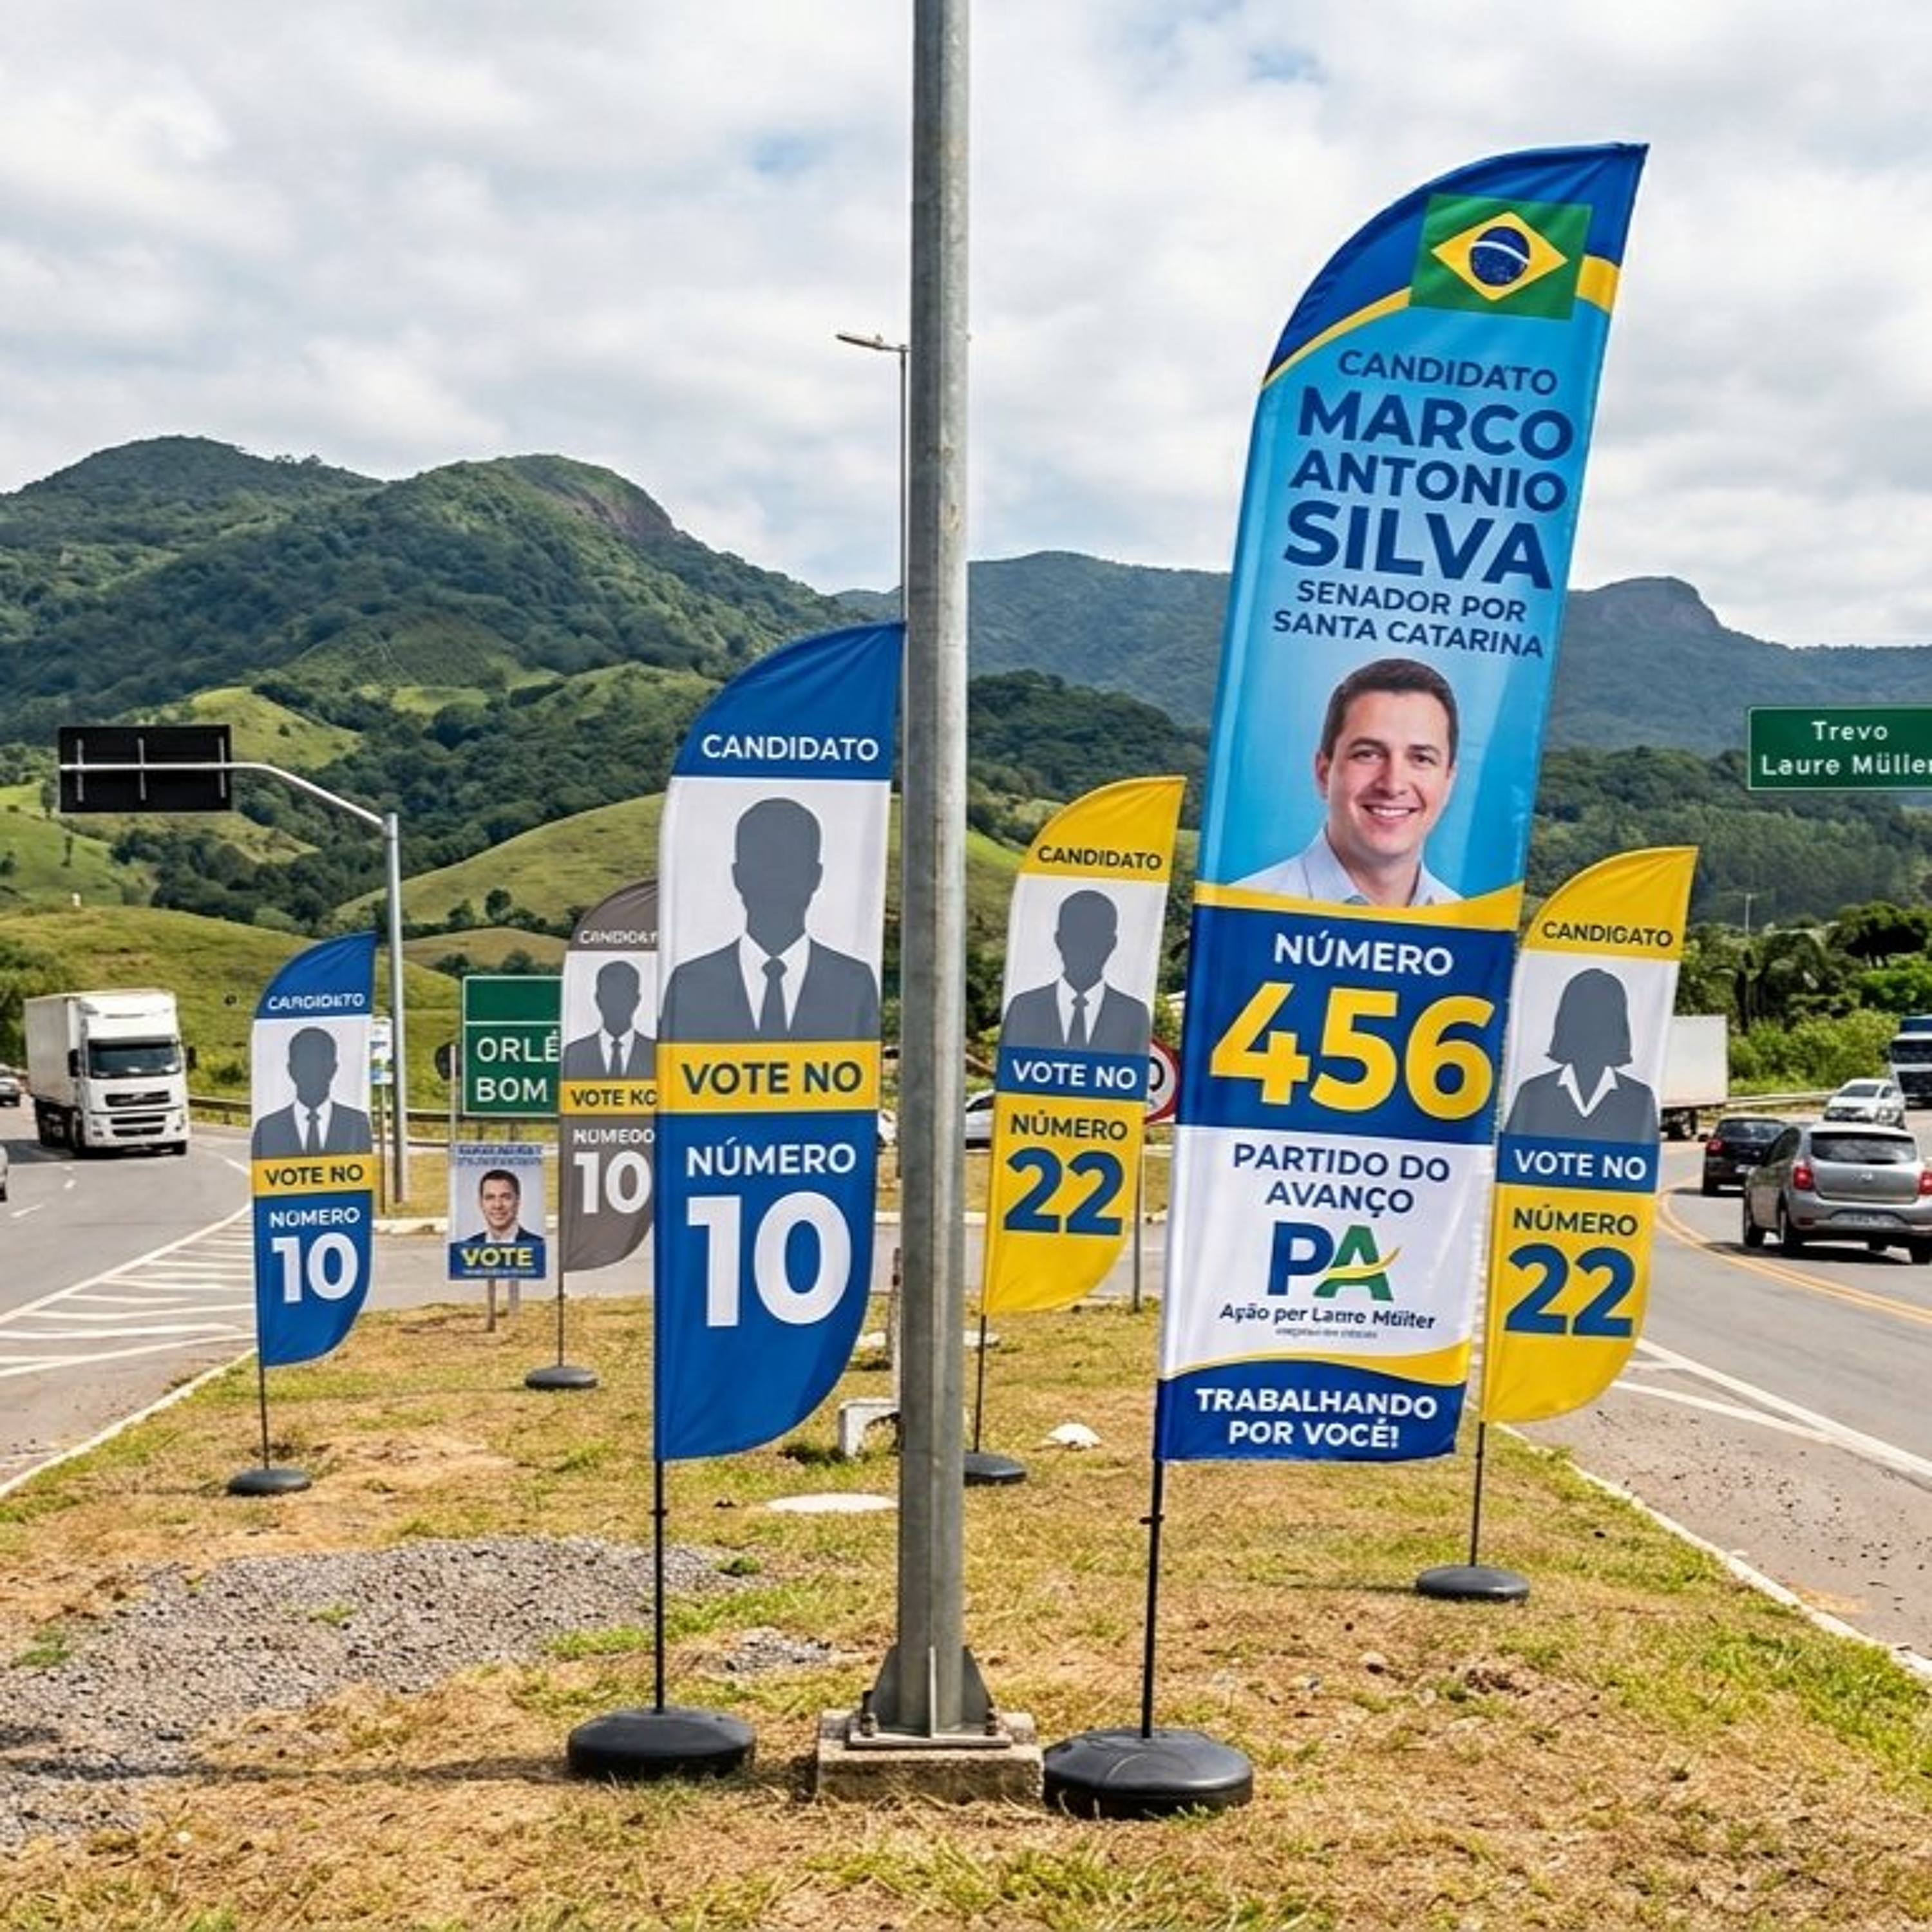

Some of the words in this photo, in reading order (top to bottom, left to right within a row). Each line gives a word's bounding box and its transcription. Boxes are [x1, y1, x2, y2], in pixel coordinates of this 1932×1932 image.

[1339, 350, 1557, 395] CANDIDATO
[1298, 386, 1573, 460] MARCO
[1291, 450, 1567, 512] ANTONIO
[1283, 500, 1552, 590] SILVA
[1298, 580, 1450, 614] SENADOR
[1462, 596, 1526, 621] POR
[1274, 611, 1377, 640] SANTA
[1387, 621, 1543, 656] CATARINA
[702, 734, 878, 762] CANDIDATO
[1811, 721, 1888, 741] Trevo
[1762, 754, 1840, 775] Laure
[1038, 846, 1162, 870] CANDIDATO
[1274, 930, 1453, 976] NÚMERO
[1209, 981, 1495, 1120] 456
[477, 1077, 548, 1103] BOM
[681, 1063, 790, 1094] VOTE
[804, 1061, 863, 1093] NO
[1012, 1059, 1086, 1086] VOTE
[1096, 1066, 1137, 1090] NO
[571, 1088, 625, 1107] VOTE
[264, 1166, 323, 1186] VOTE
[687, 1136, 857, 1177] NÚMERO
[1234, 1144, 1388, 1177] PARTIDO
[1400, 1155, 1450, 1182] DO
[1515, 1149, 1593, 1177] VOTE
[1602, 1155, 1647, 1180] NO
[574, 1151, 652, 1214] 10
[1004, 1146, 1124, 1235] 22
[1265, 1181, 1414, 1218] AVANÇO
[272, 1233, 358, 1303] 10
[461, 1247, 534, 1267] VOTE
[687, 1191, 851, 1327] 10
[1267, 1220, 1394, 1302] PA
[1504, 1242, 1635, 1338] 22
[1196, 1388, 1437, 1419] TRABALHANDO
[1229, 1421, 1294, 1444] POR
